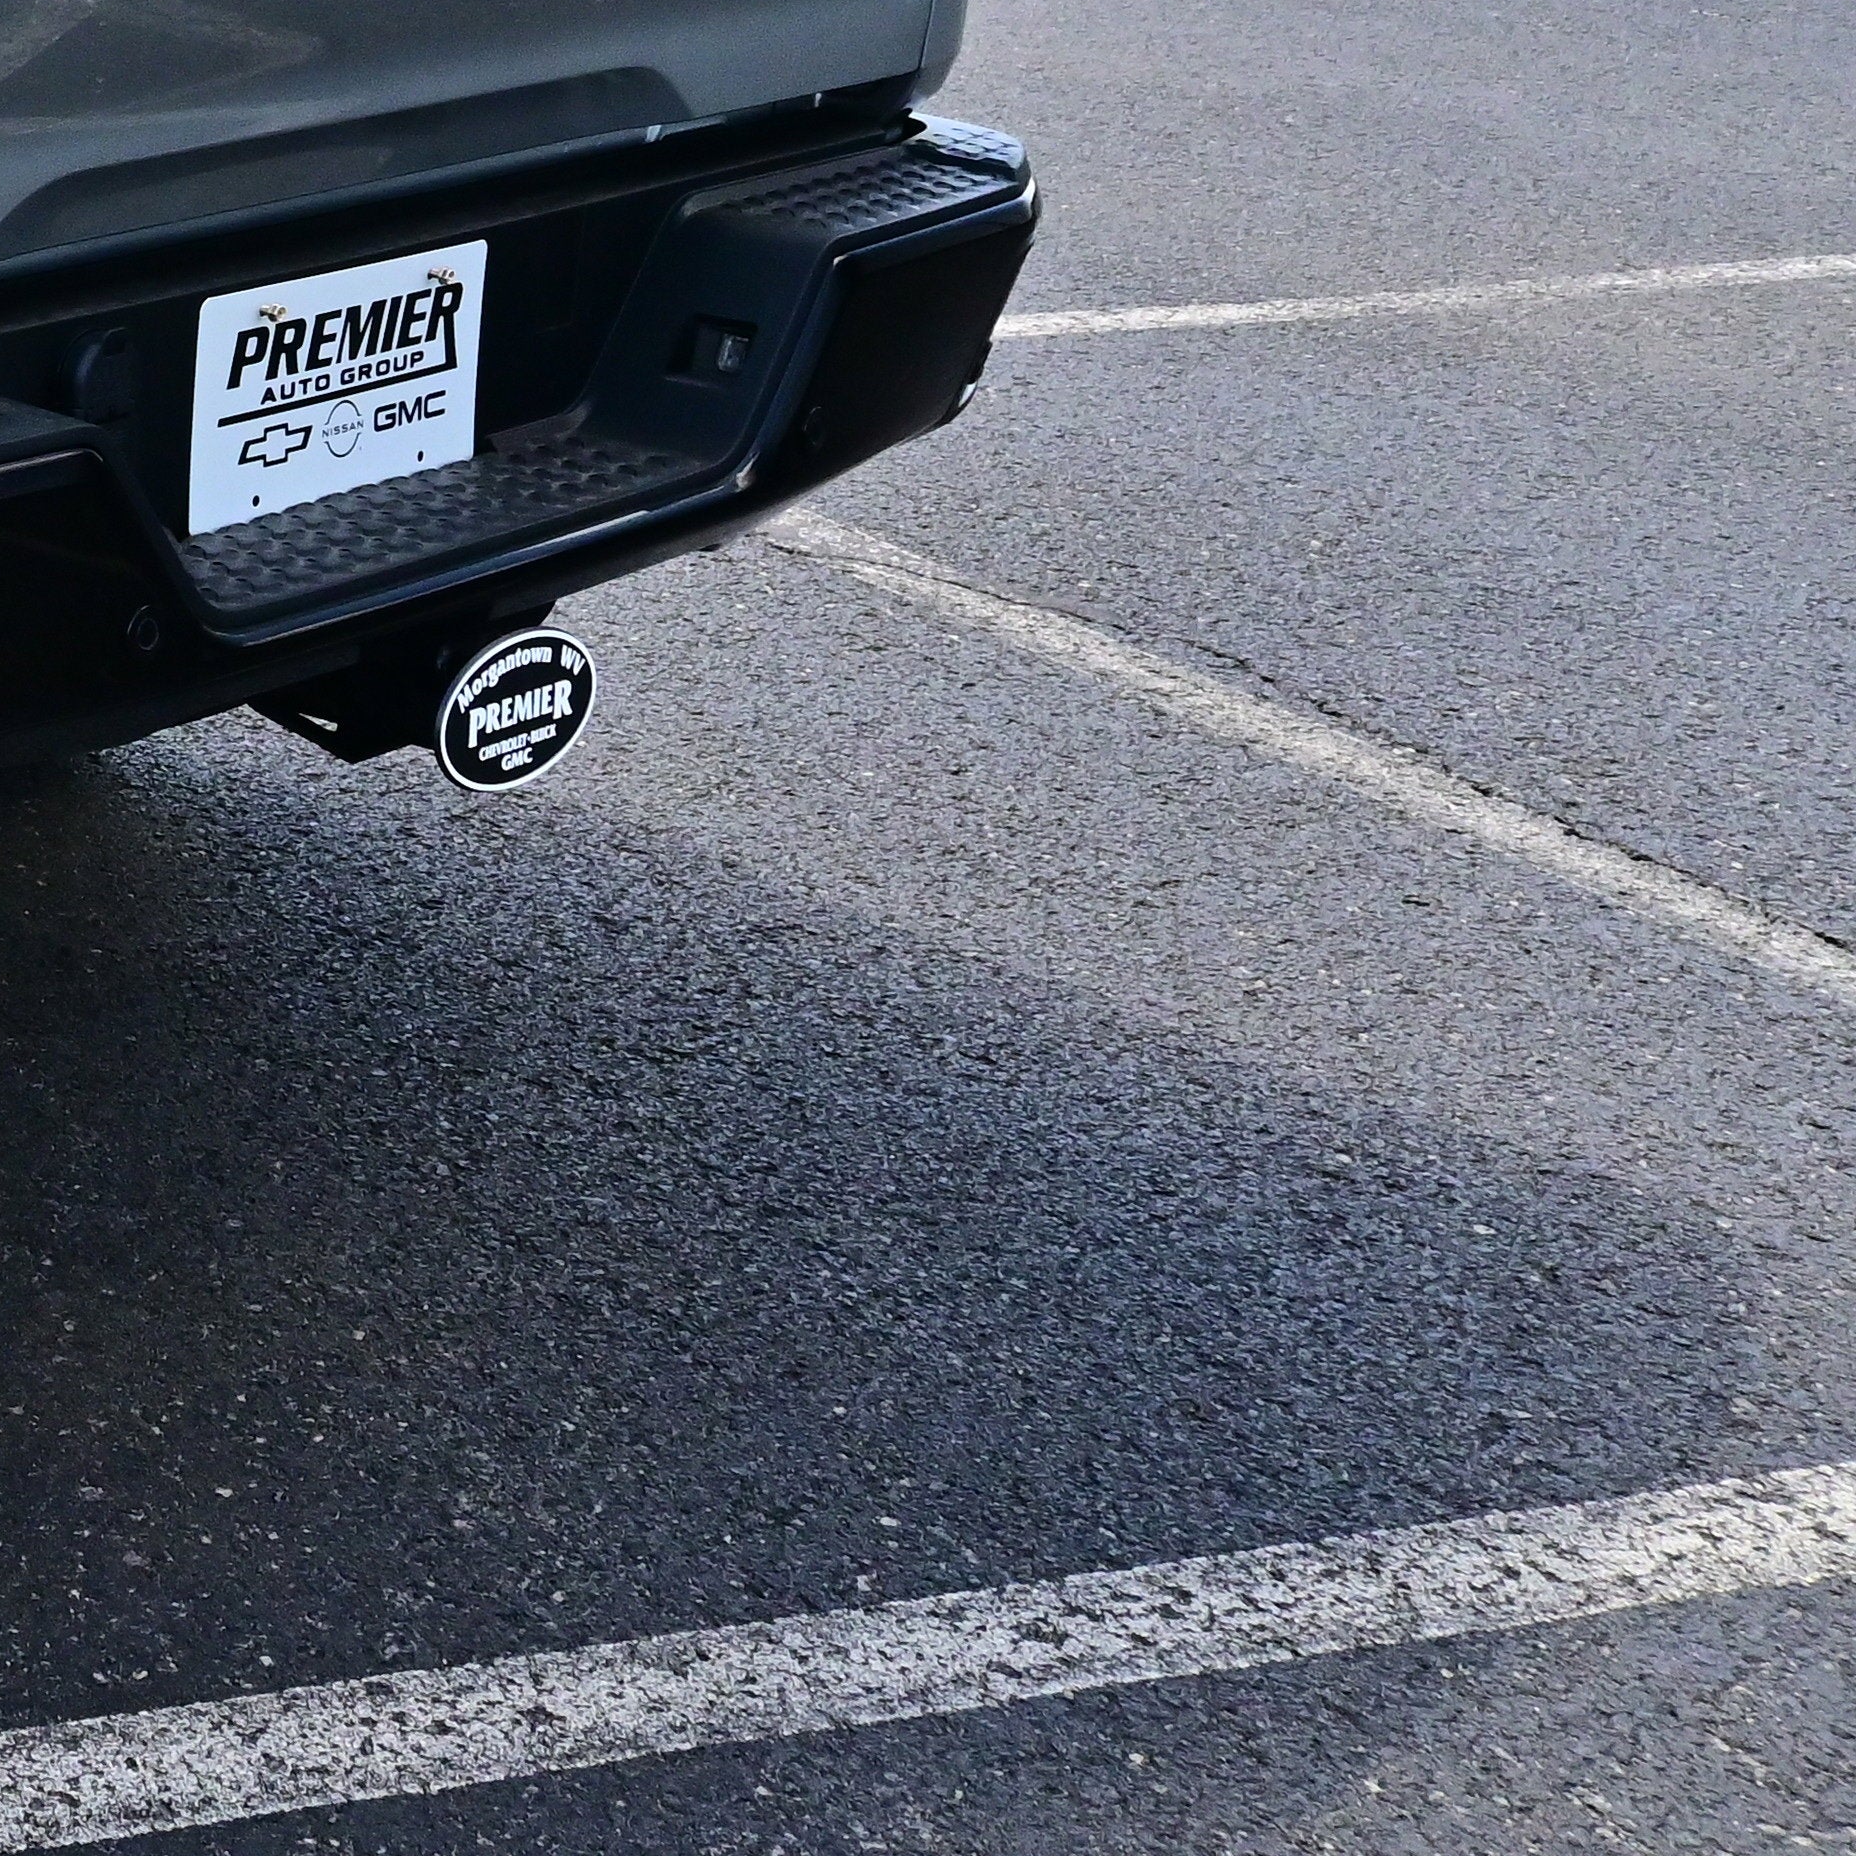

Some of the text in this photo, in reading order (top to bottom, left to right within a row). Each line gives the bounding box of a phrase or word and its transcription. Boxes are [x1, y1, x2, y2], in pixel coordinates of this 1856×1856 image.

[226, 282, 464, 390] PREMIER
[260, 350, 425, 405] AUTO GROUP
[321, 419, 365, 438] NISSAN
[373, 390, 447, 432] GMC
[456, 644, 586, 714] Morgantown WV
[467, 679, 573, 749] PREMIER
[500, 748, 534, 771] GMC
